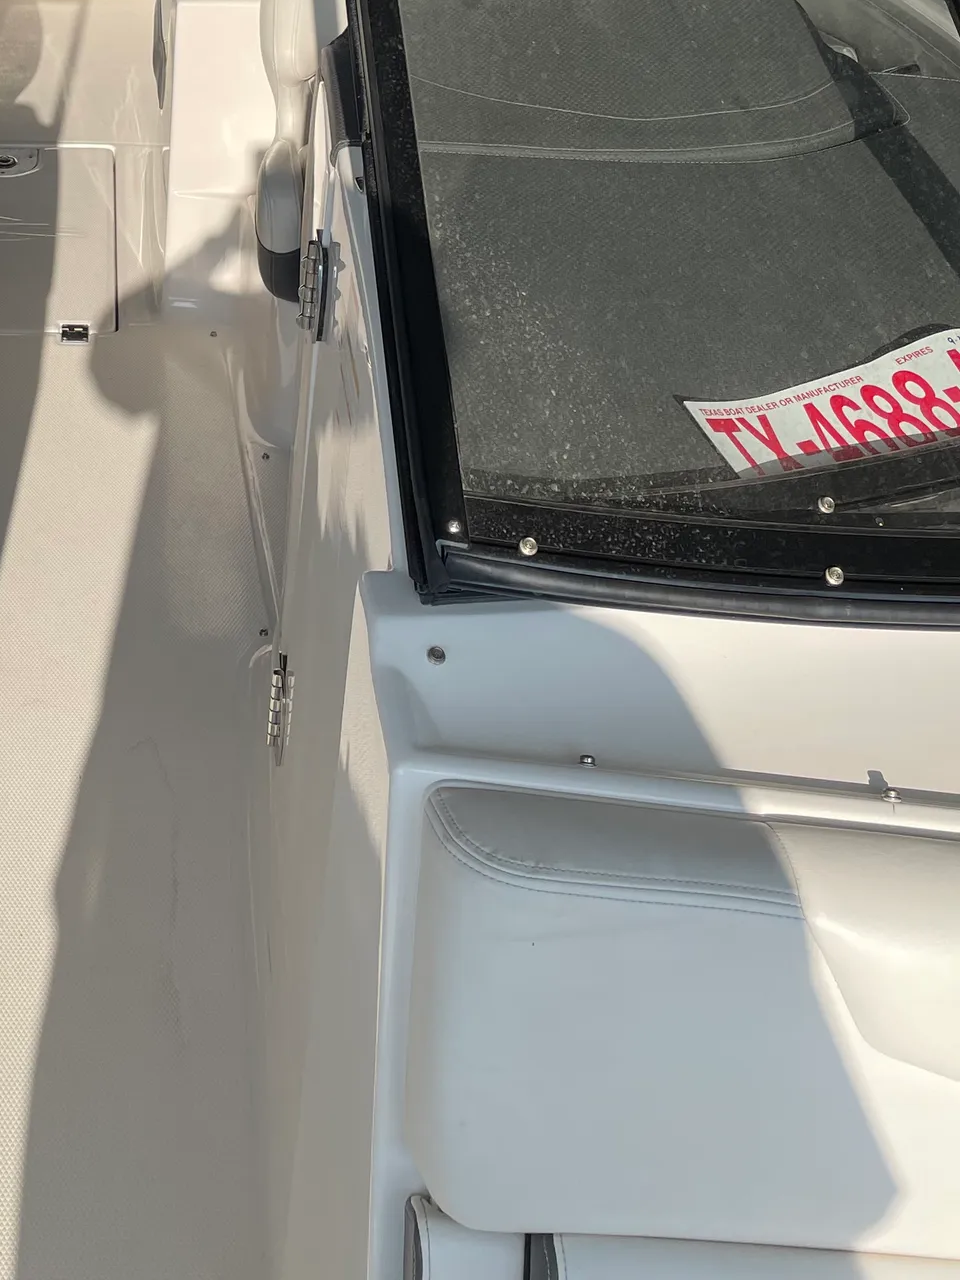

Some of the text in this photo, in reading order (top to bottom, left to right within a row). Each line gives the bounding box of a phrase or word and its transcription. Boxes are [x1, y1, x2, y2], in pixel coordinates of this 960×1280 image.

[699, 346, 934, 417] TEXAS BOAT DEALER OR MANUFACTURER EXPIRES
